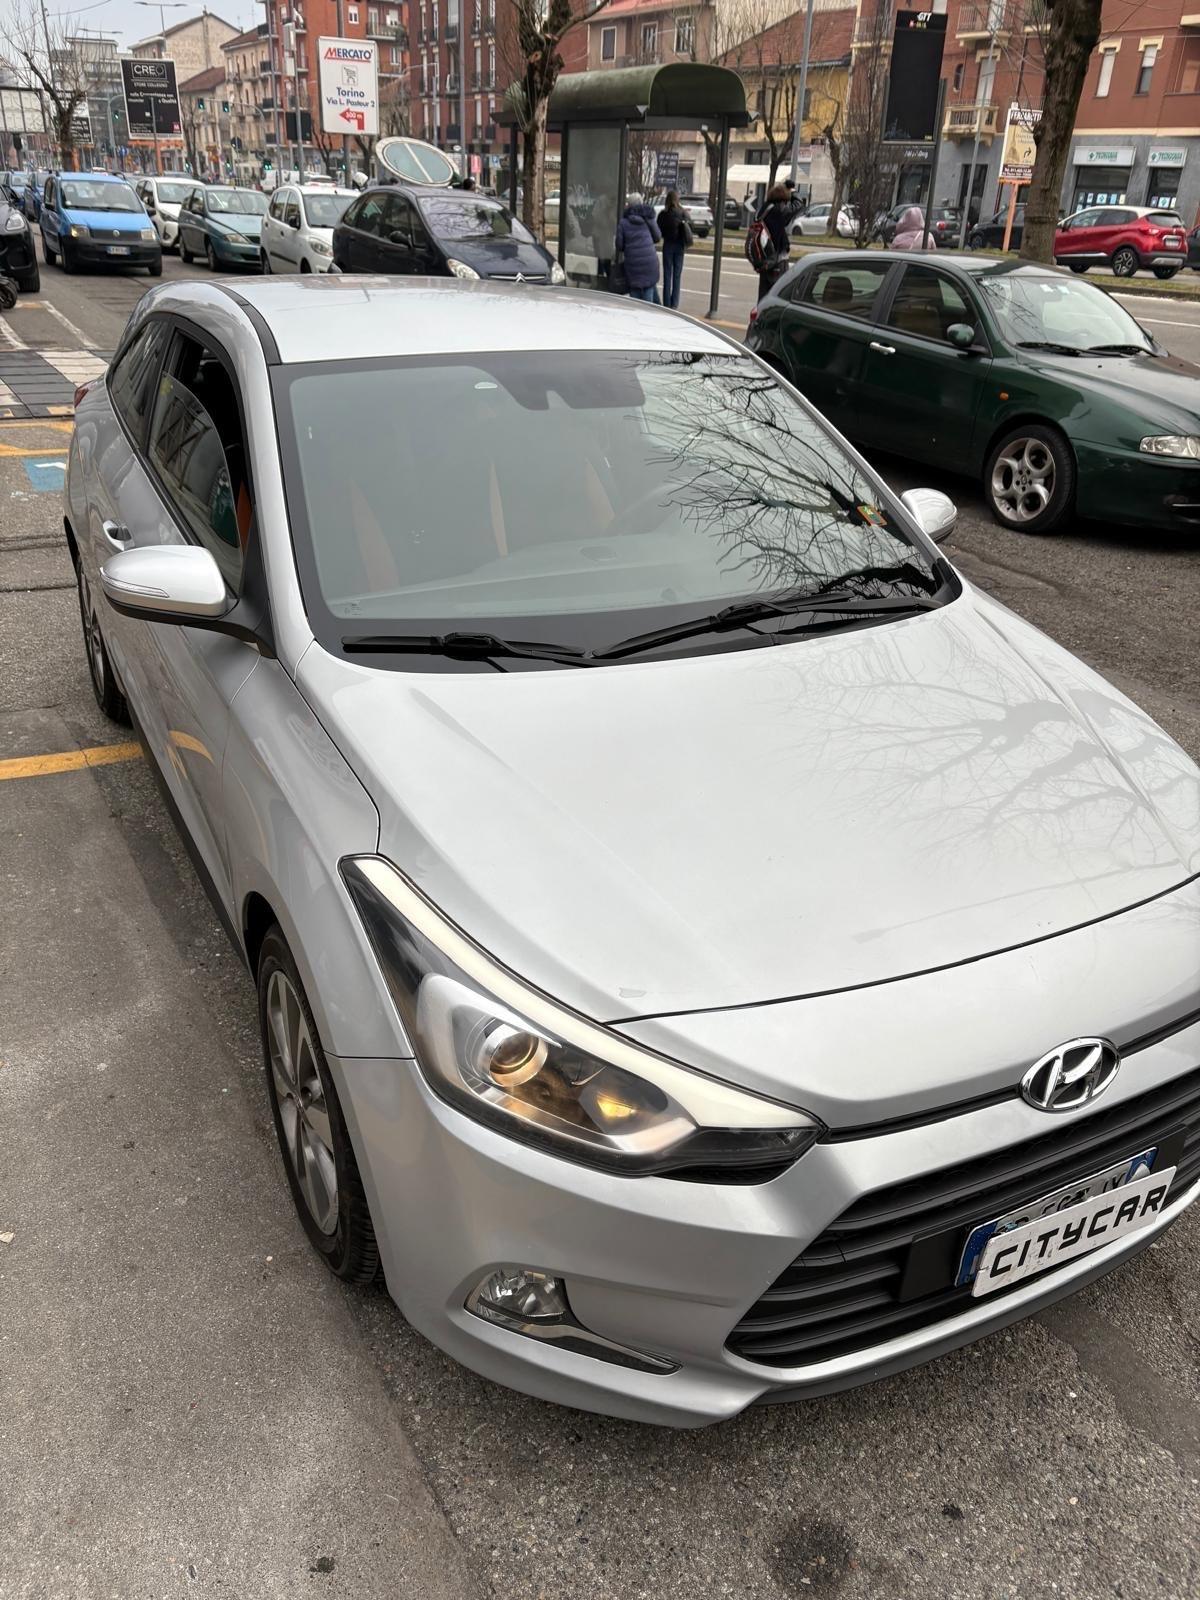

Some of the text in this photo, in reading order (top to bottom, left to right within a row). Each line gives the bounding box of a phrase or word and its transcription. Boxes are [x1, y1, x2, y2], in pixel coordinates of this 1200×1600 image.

[134, 65, 164, 75] CREO
[336, 86, 365, 98] Torino
[326, 97, 338, 105] Via
[346, 99, 370, 107] Pasteur
[990, 1185, 1167, 1278] CITYCAR
